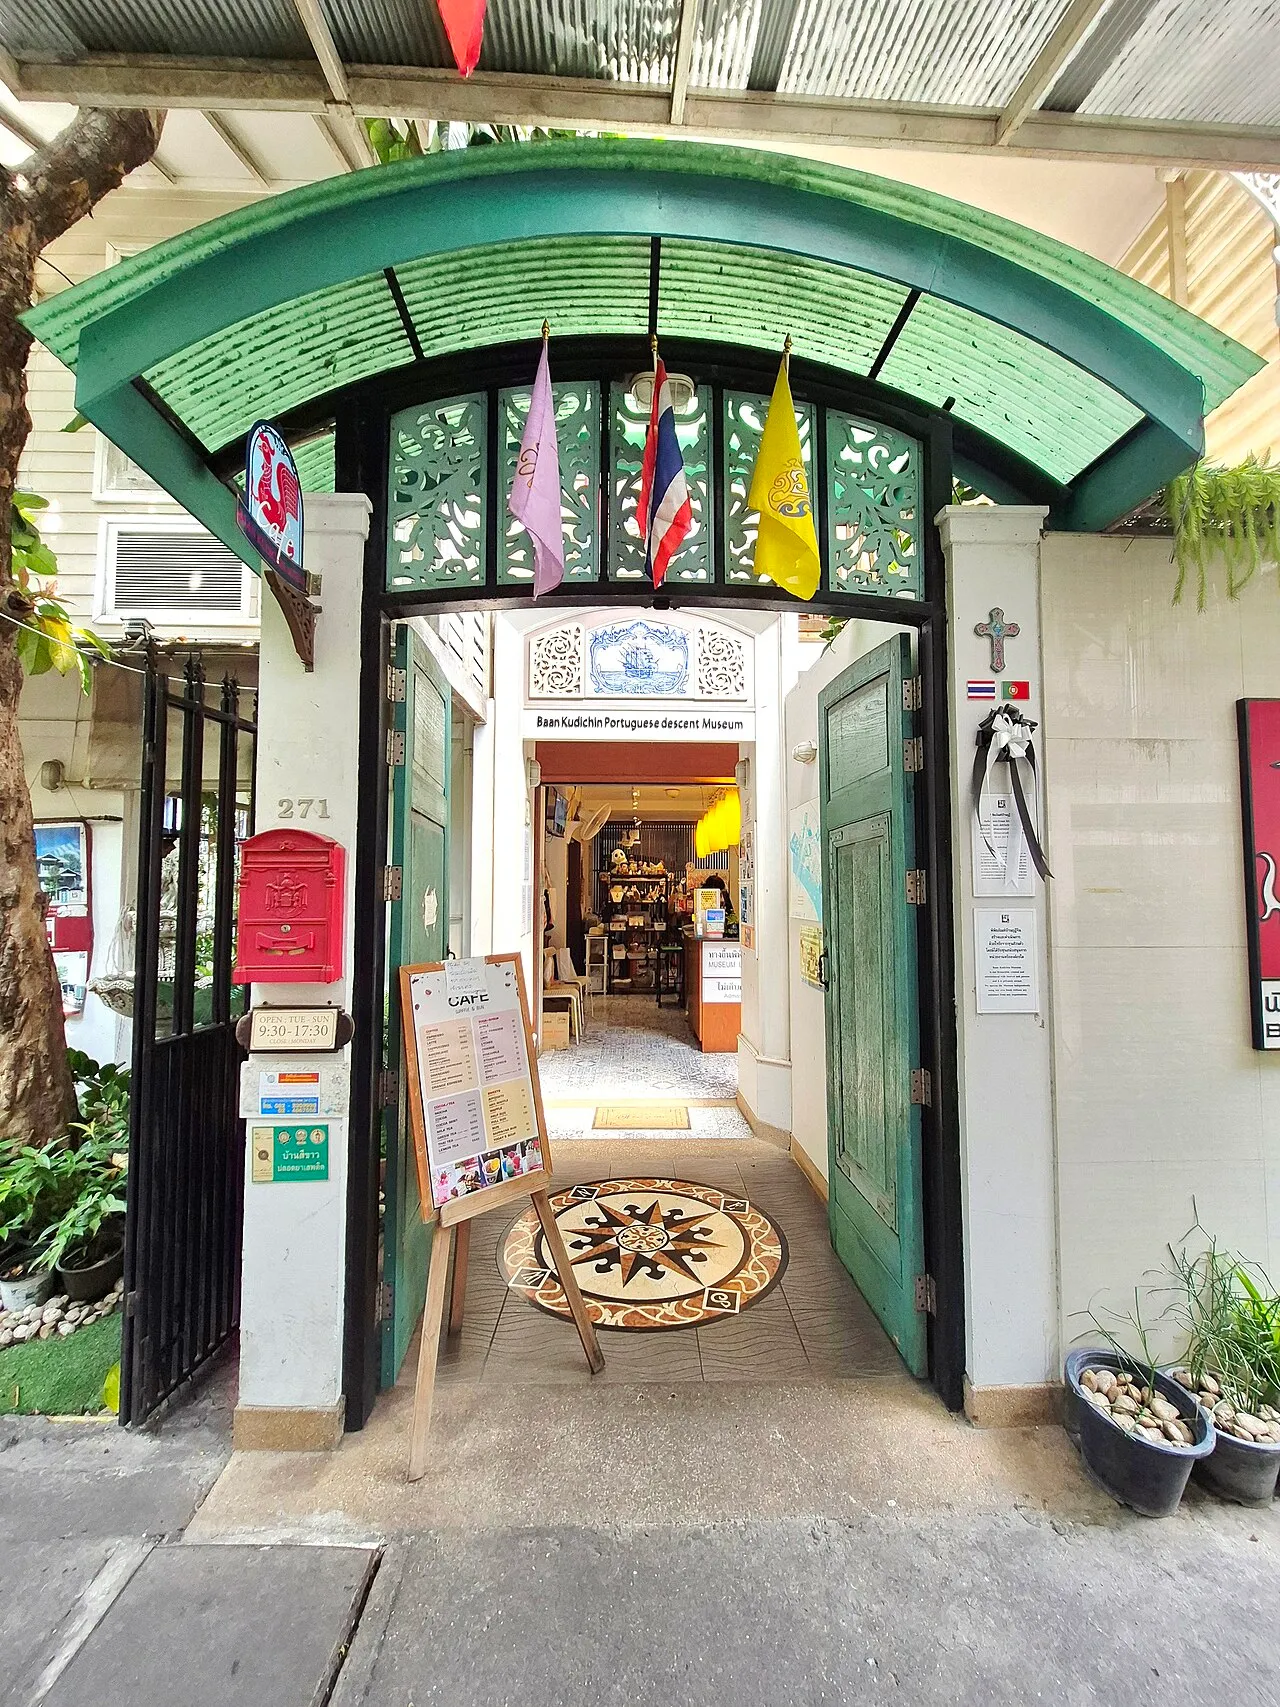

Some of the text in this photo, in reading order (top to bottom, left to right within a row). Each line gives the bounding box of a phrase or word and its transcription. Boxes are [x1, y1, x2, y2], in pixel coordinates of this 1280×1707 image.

[536, 716, 743, 731] Baan Kudichin Portuguese descent Museum
[278, 798, 331, 819] 271
